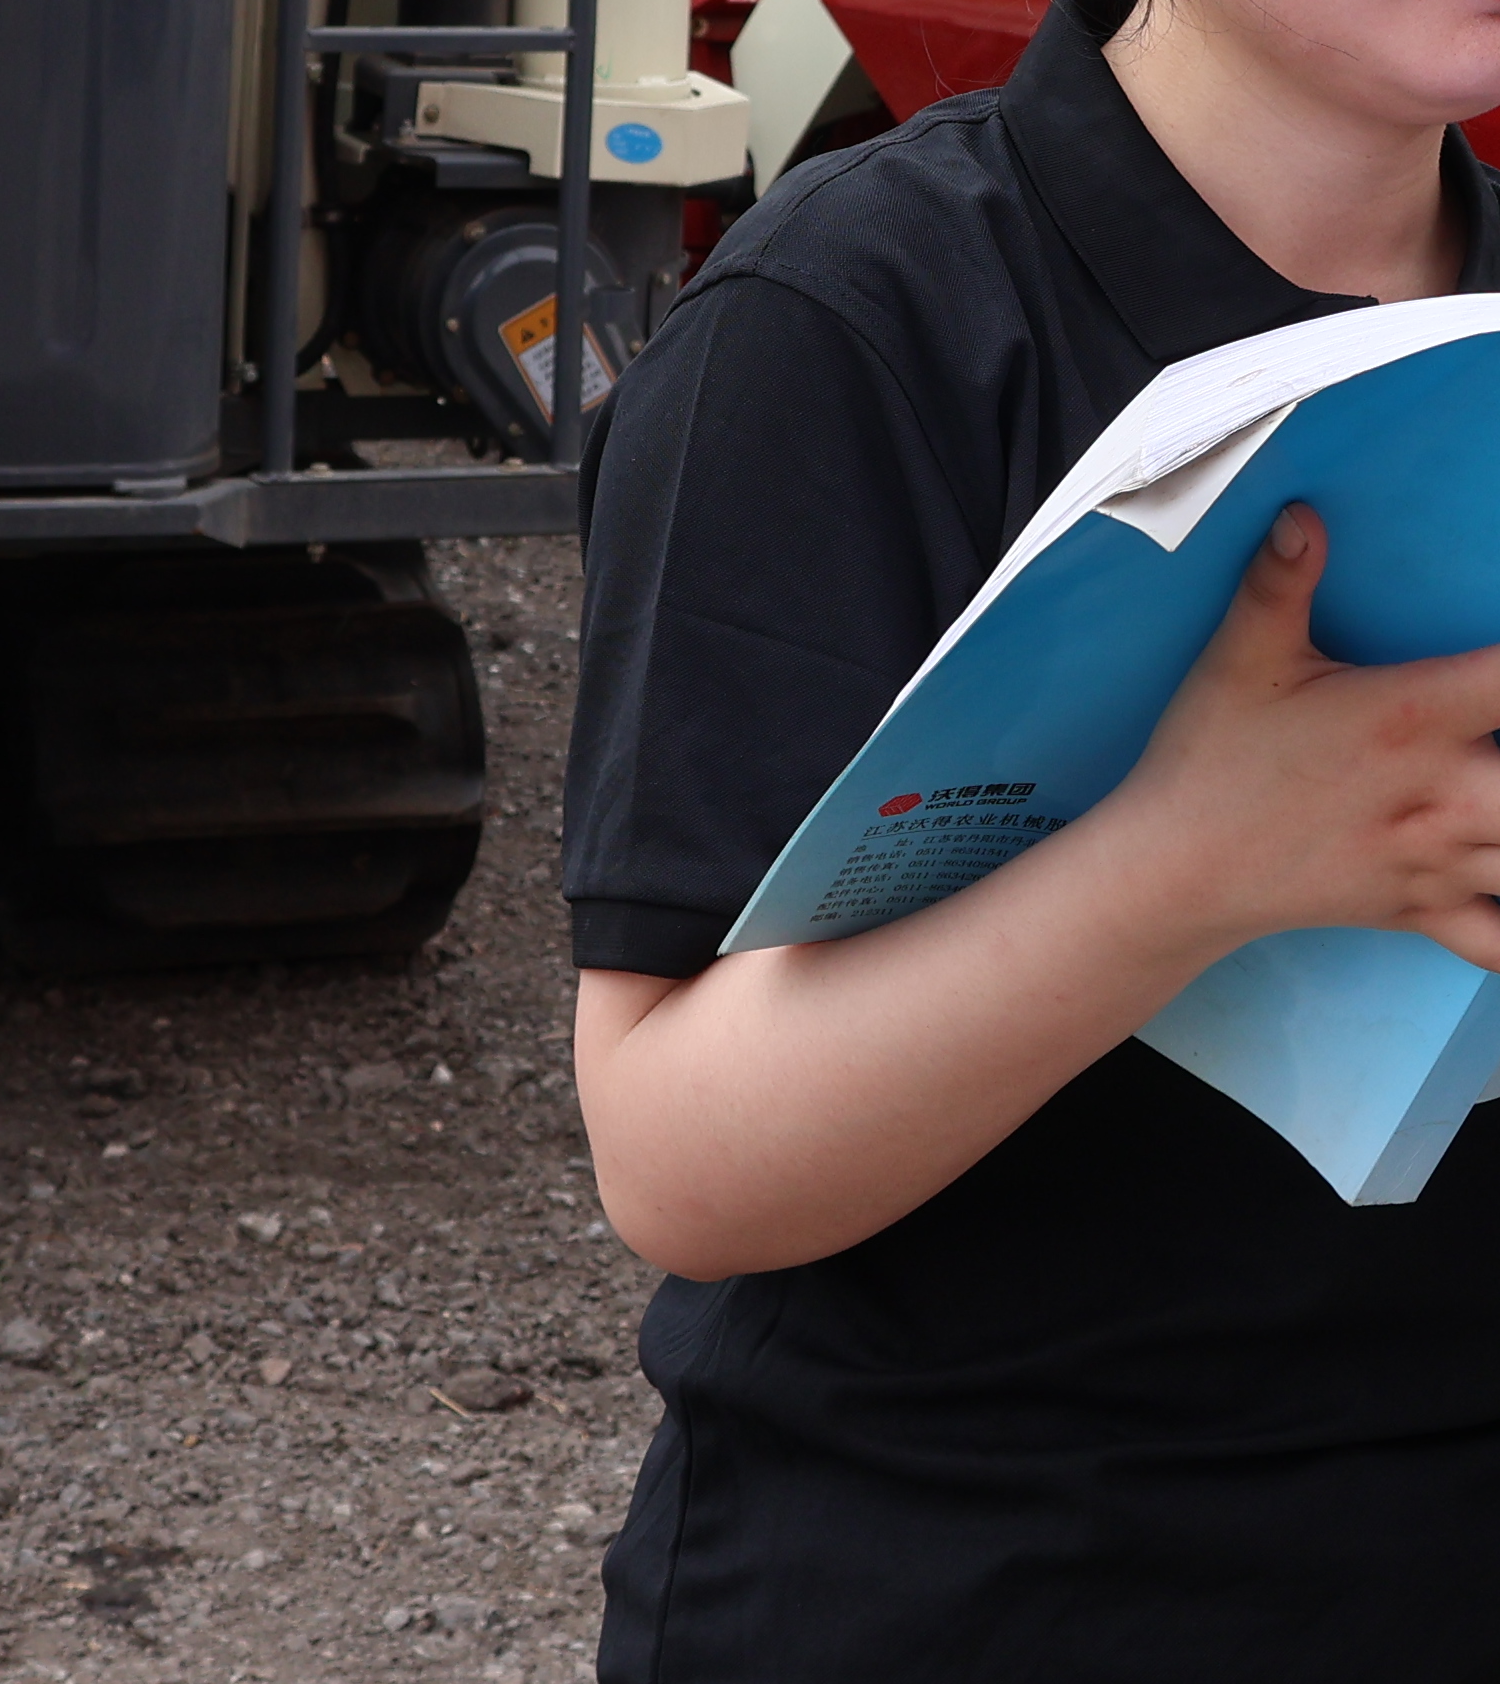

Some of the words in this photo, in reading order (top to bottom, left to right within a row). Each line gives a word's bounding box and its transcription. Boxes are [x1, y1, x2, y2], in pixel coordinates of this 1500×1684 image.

[927, 782, 1037, 802] 沃得集团
[925, 799, 975, 811] WORLD
[976, 797, 1028, 806] GROUP
